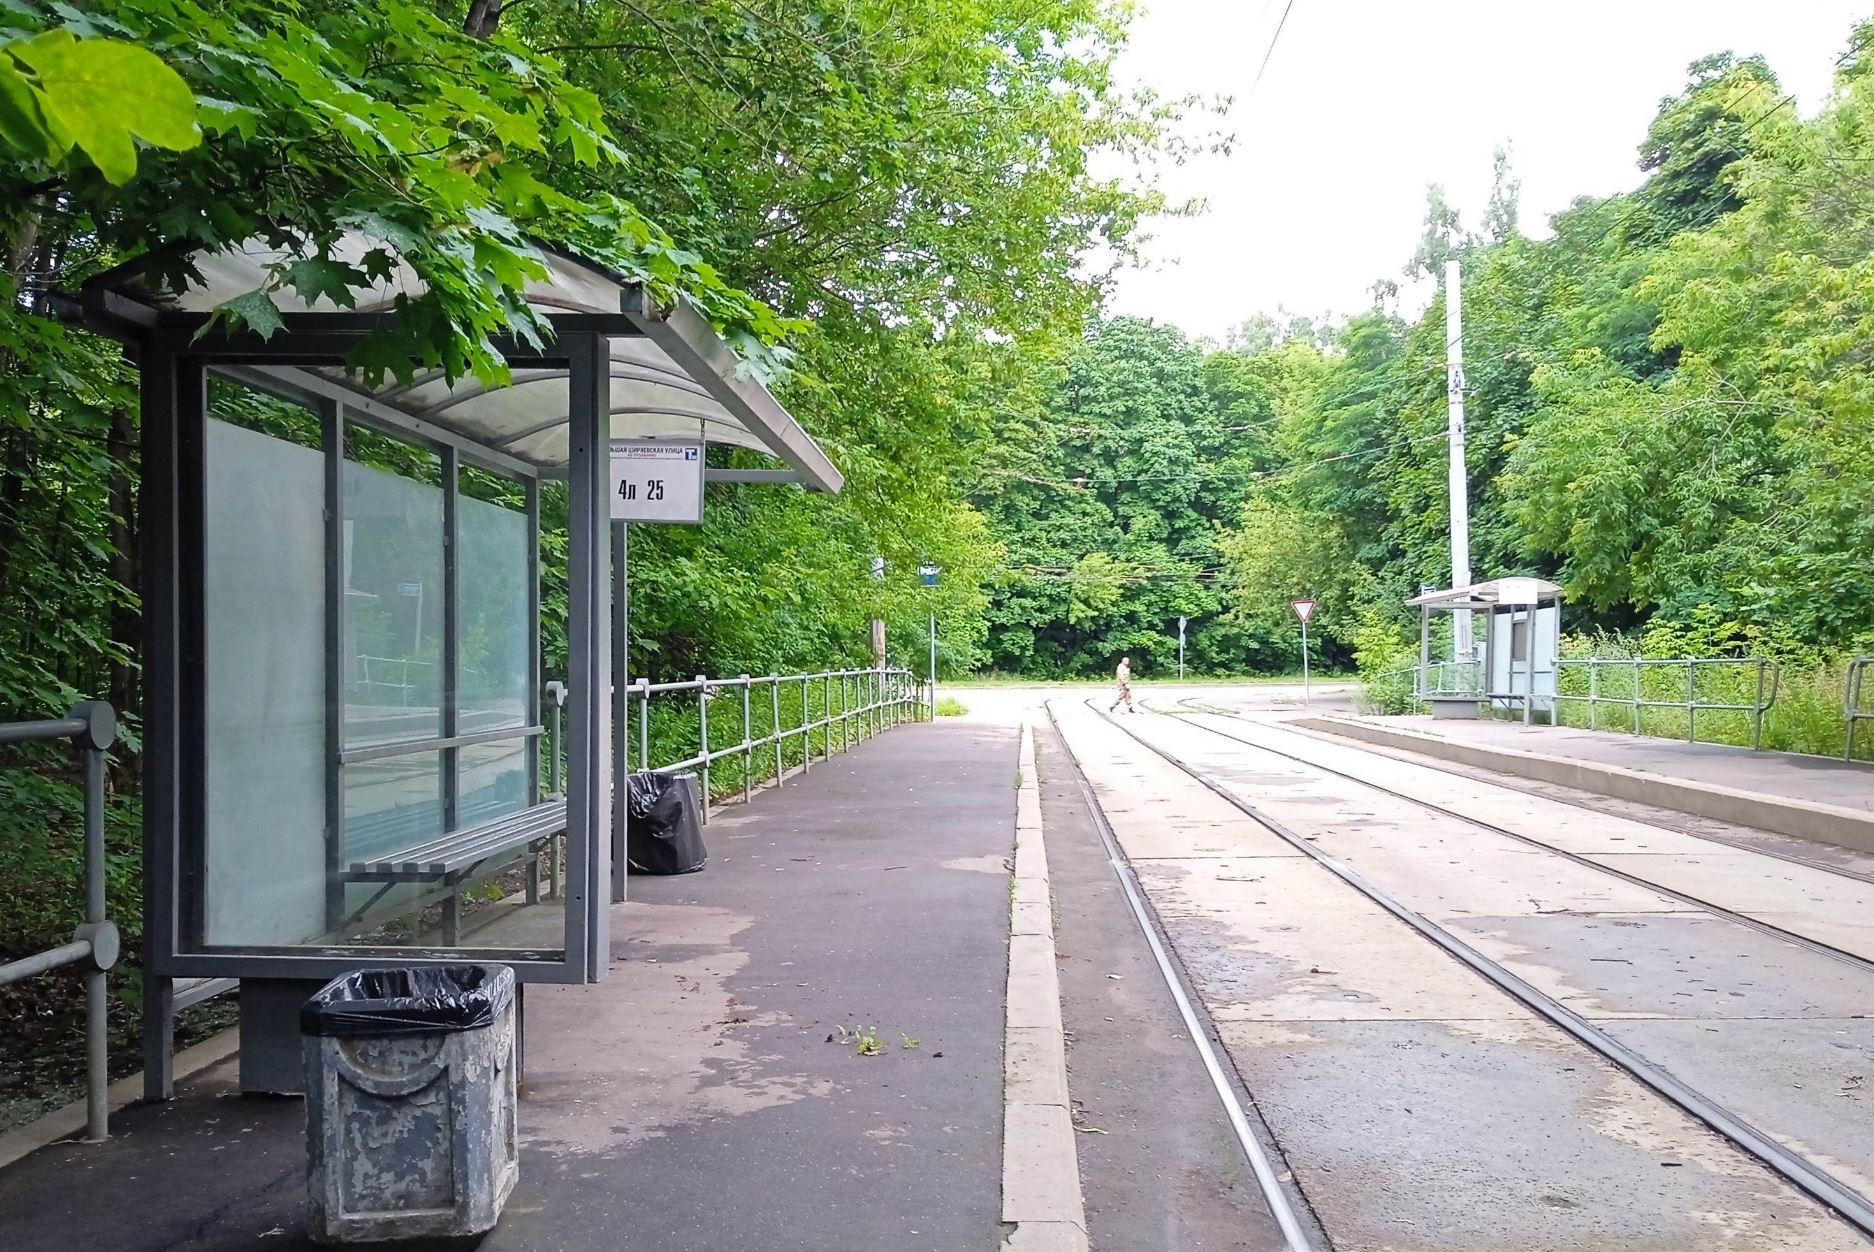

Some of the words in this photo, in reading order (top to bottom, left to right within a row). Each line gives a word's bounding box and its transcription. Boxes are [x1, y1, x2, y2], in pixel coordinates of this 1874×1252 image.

[665, 447, 683, 455] УЛИЦА
[618, 479, 636, 500] 4л
[647, 479, 664, 501] 25
